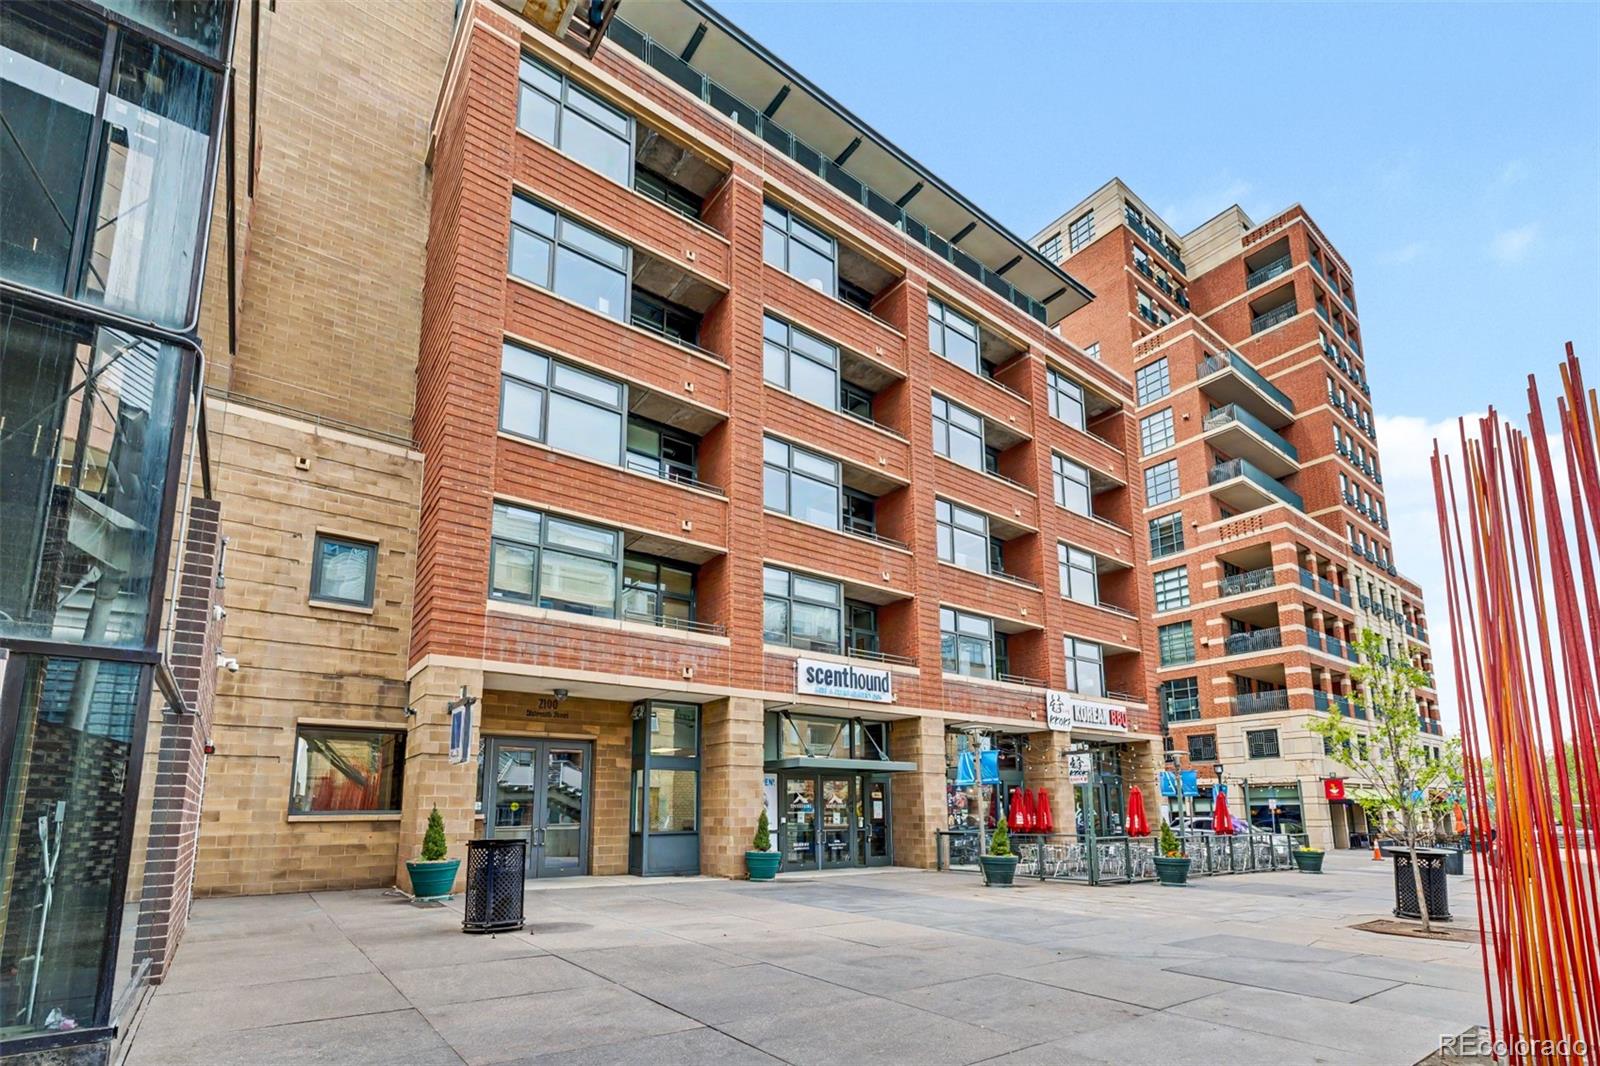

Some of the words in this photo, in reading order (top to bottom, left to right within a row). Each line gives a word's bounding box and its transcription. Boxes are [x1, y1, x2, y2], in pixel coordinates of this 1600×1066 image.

[806, 666, 890, 693] scenthound
[538, 698, 559, 710] 2100
[1073, 704, 1108, 726] KOREAN
[1109, 709, 1128, 729] BBQ
